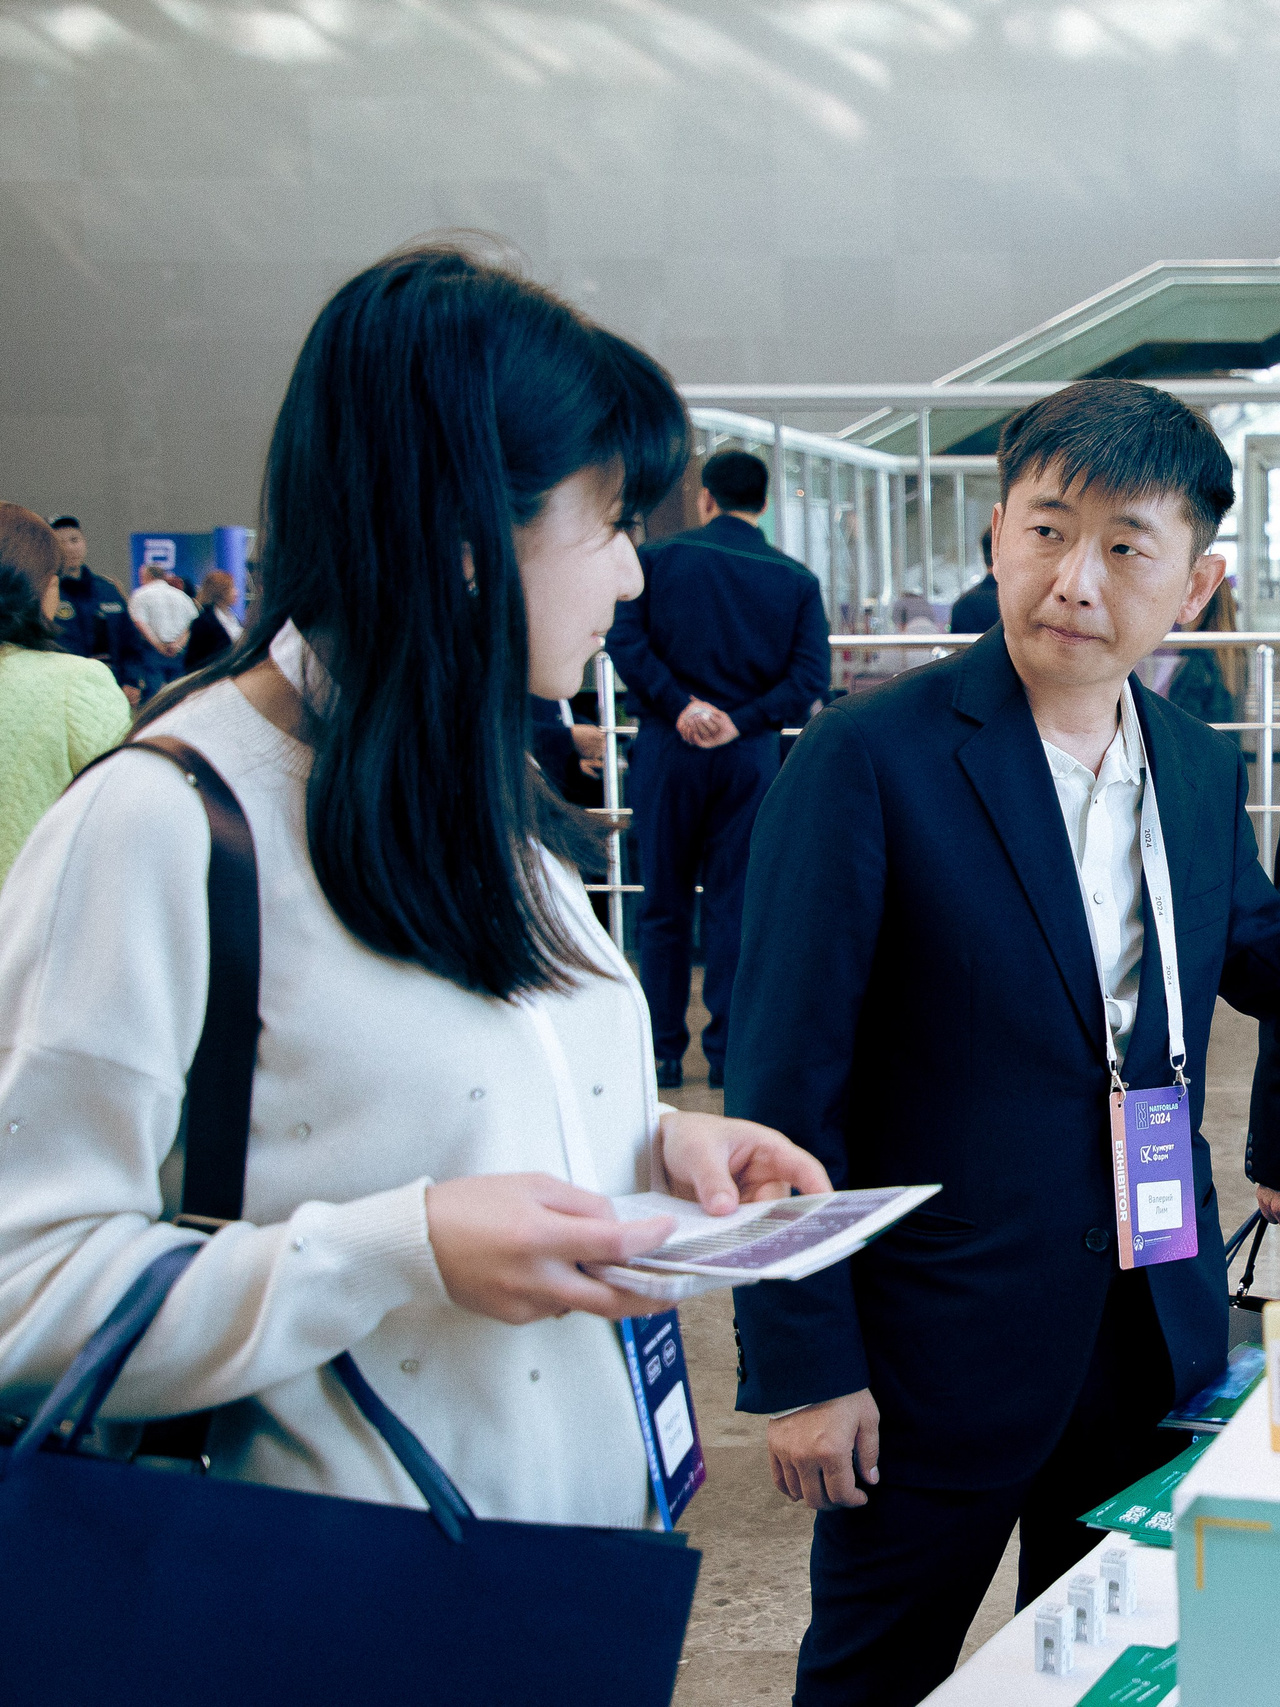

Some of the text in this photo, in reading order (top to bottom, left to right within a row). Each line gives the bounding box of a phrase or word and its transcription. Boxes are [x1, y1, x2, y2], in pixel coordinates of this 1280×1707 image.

[1144, 828, 1152, 848] 2024
[1155, 895, 1164, 917] 2024
[1165, 965, 1173, 986] 2024
[1149, 1103, 1179, 1112] NATFORLAB
[1150, 1112, 1171, 1125] 2024
[1115, 1140, 1128, 1223] EXHIBITOR
[1155, 1206, 1168, 1215] Лим
